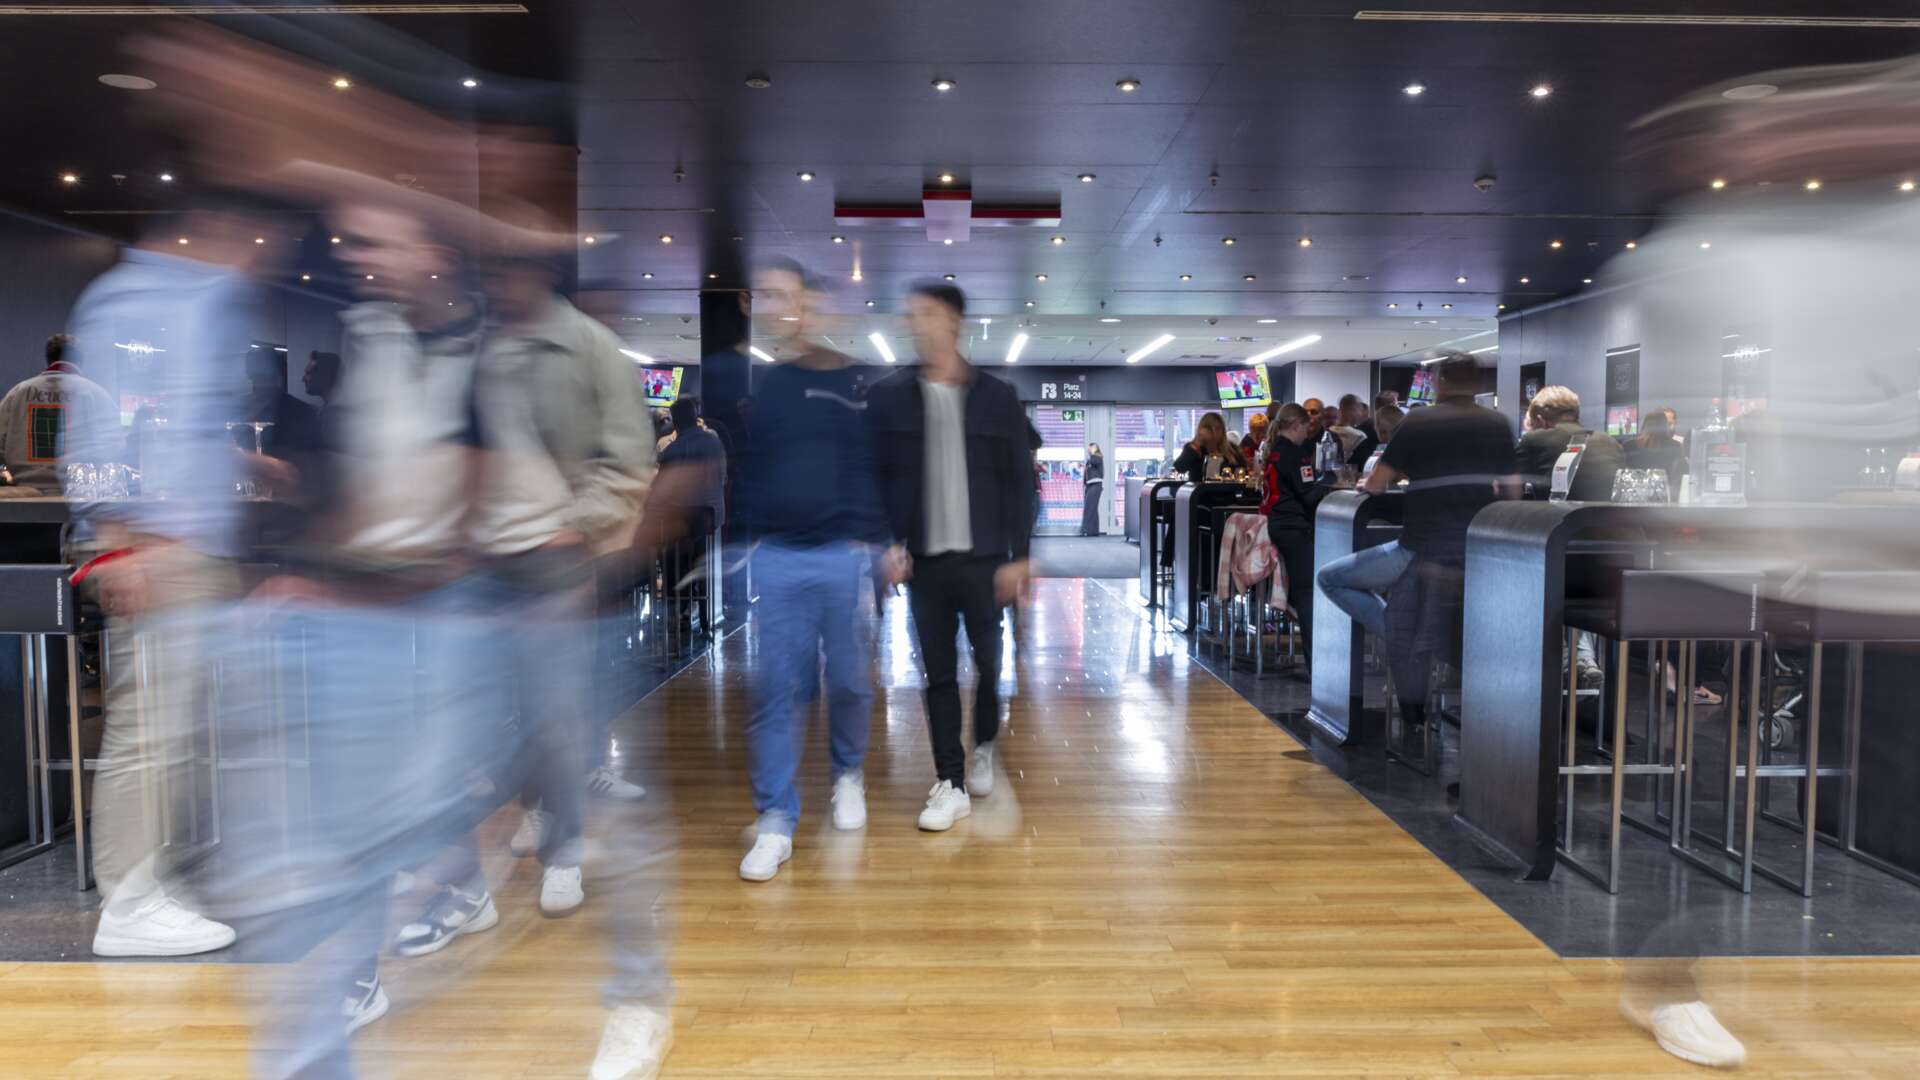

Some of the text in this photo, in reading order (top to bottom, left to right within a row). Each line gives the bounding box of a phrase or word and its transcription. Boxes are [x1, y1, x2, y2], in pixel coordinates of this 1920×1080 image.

[1041, 383, 1057, 399] F3
[1063, 383, 1080, 391] Platz
[1063, 391, 1082, 399] 14-24
